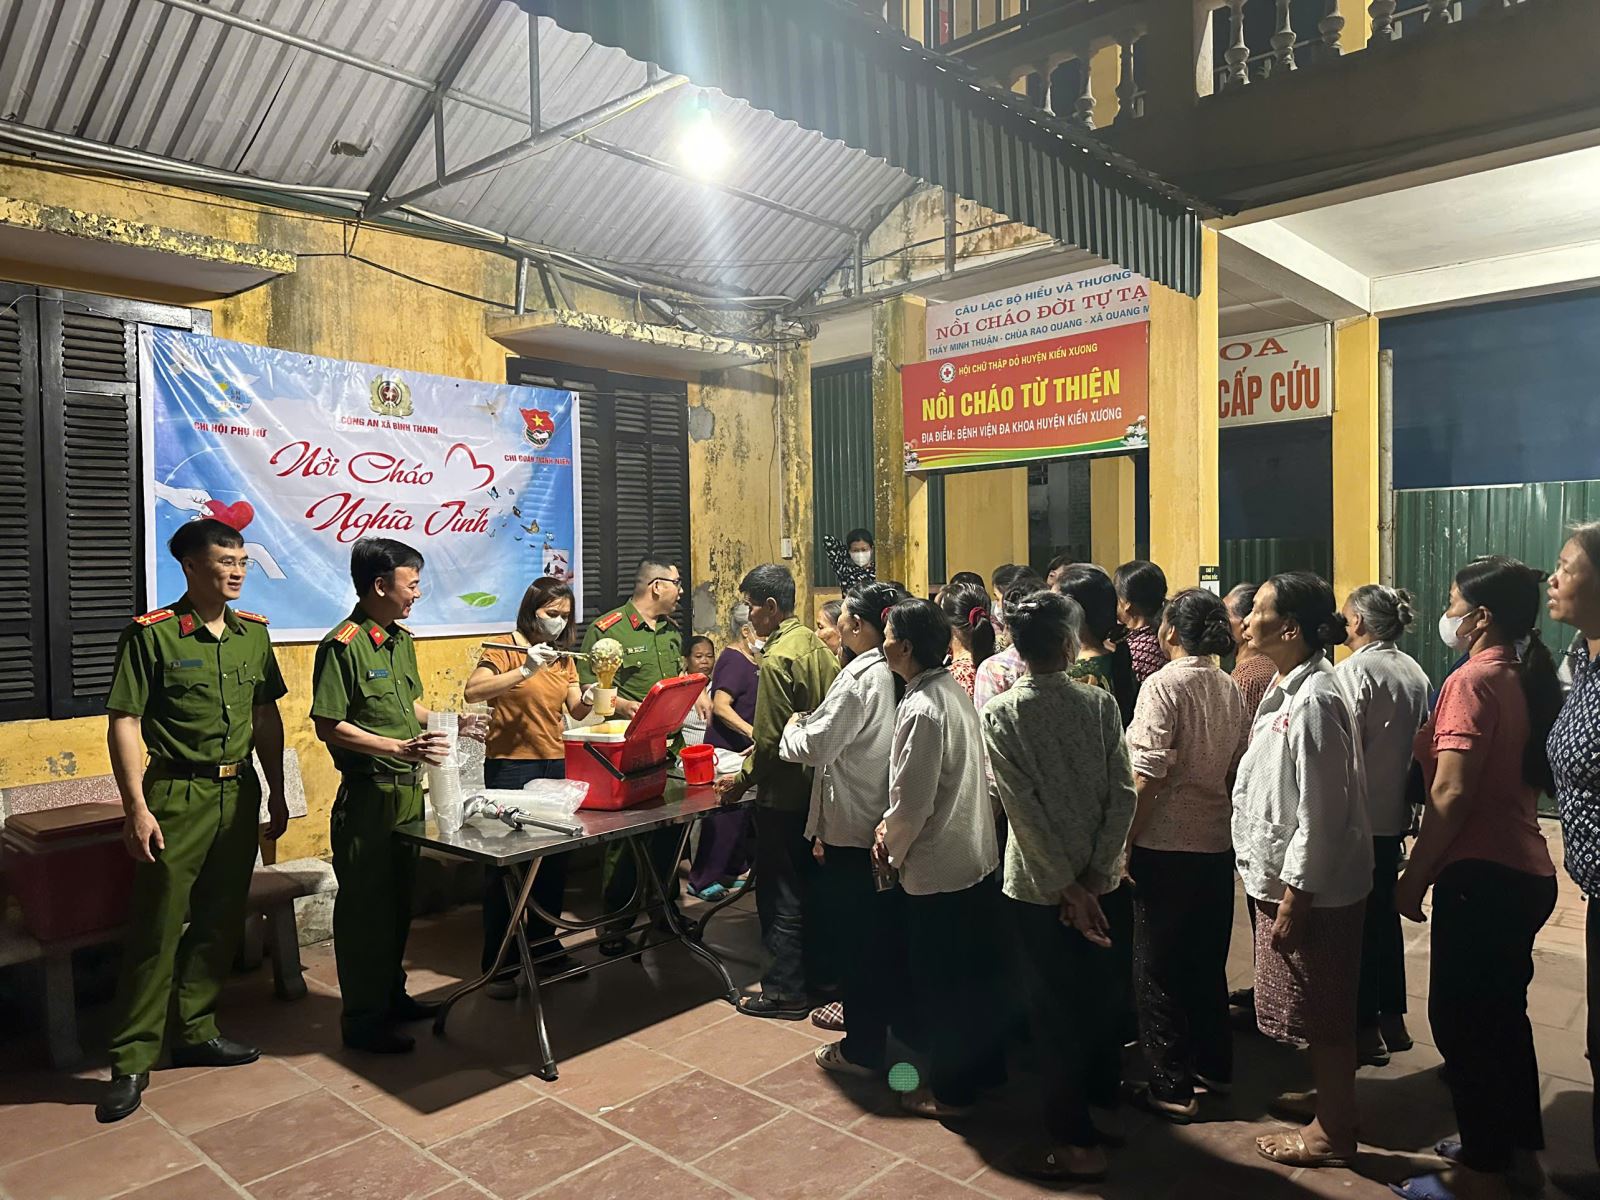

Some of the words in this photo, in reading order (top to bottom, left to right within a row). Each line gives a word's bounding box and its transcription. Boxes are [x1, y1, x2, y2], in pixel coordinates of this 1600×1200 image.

[936, 318, 969, 341] NỒI
[976, 308, 1030, 332] CHÁO
[1037, 298, 1076, 320] ĐỜI
[1082, 290, 1112, 312] TỰ
[955, 304, 978, 316] CÂU
[981, 300, 1003, 313] LẠC
[1006, 293, 1022, 305] BỘ
[1025, 285, 1052, 300] HIỂU
[1056, 280, 1073, 293] VÀ
[1078, 270, 1131, 289] THƯƠNG
[949, 341, 969, 352] MINH
[972, 335, 999, 348] THUẬN
[1005, 328, 1028, 341] CHÙA
[1030, 325, 1048, 336] RAO
[1050, 319, 1082, 332] QUANG
[1090, 313, 1103, 324] XÃ
[1106, 306, 1140, 321] QUANG
[959, 364, 971, 376] HỘI
[972, 361, 987, 374] CHỮ
[988, 359, 1007, 371] THẬP
[1021, 353, 1047, 366] HUYỆN
[1048, 345, 1067, 360] KIẾN
[1068, 342, 1098, 357] XƯƠNG
[922, 388, 954, 422] NỒI
[960, 383, 1014, 417] CHÁO
[1020, 376, 1049, 408] TỪ
[1053, 367, 1120, 405] THIỆN
[1219, 367, 1262, 419] CẤP
[1270, 360, 1320, 413] CỨU
[194, 422, 208, 431] CHI
[211, 423, 227, 435] HỘI
[231, 426, 249, 437] PHỤ
[341, 416, 364, 425] CÔNG
[367, 419, 378, 428] AN
[412, 425, 438, 434] THANH
[921, 431, 934, 444] ĐỊA
[957, 424, 978, 440] BỆNH
[980, 421, 997, 439] VIỆN
[999, 422, 1011, 435] ĐA
[1012, 418, 1034, 433] KHOA
[1036, 414, 1065, 430] HUYỆN
[1067, 408, 1088, 424] KIẾN
[1090, 407, 1122, 423] XƯƠNG
[269, 441, 341, 477] Nồi
[348, 451, 434, 485] Cháo
[305, 492, 415, 543] Nghĩa
[424, 500, 489, 536] Tình
